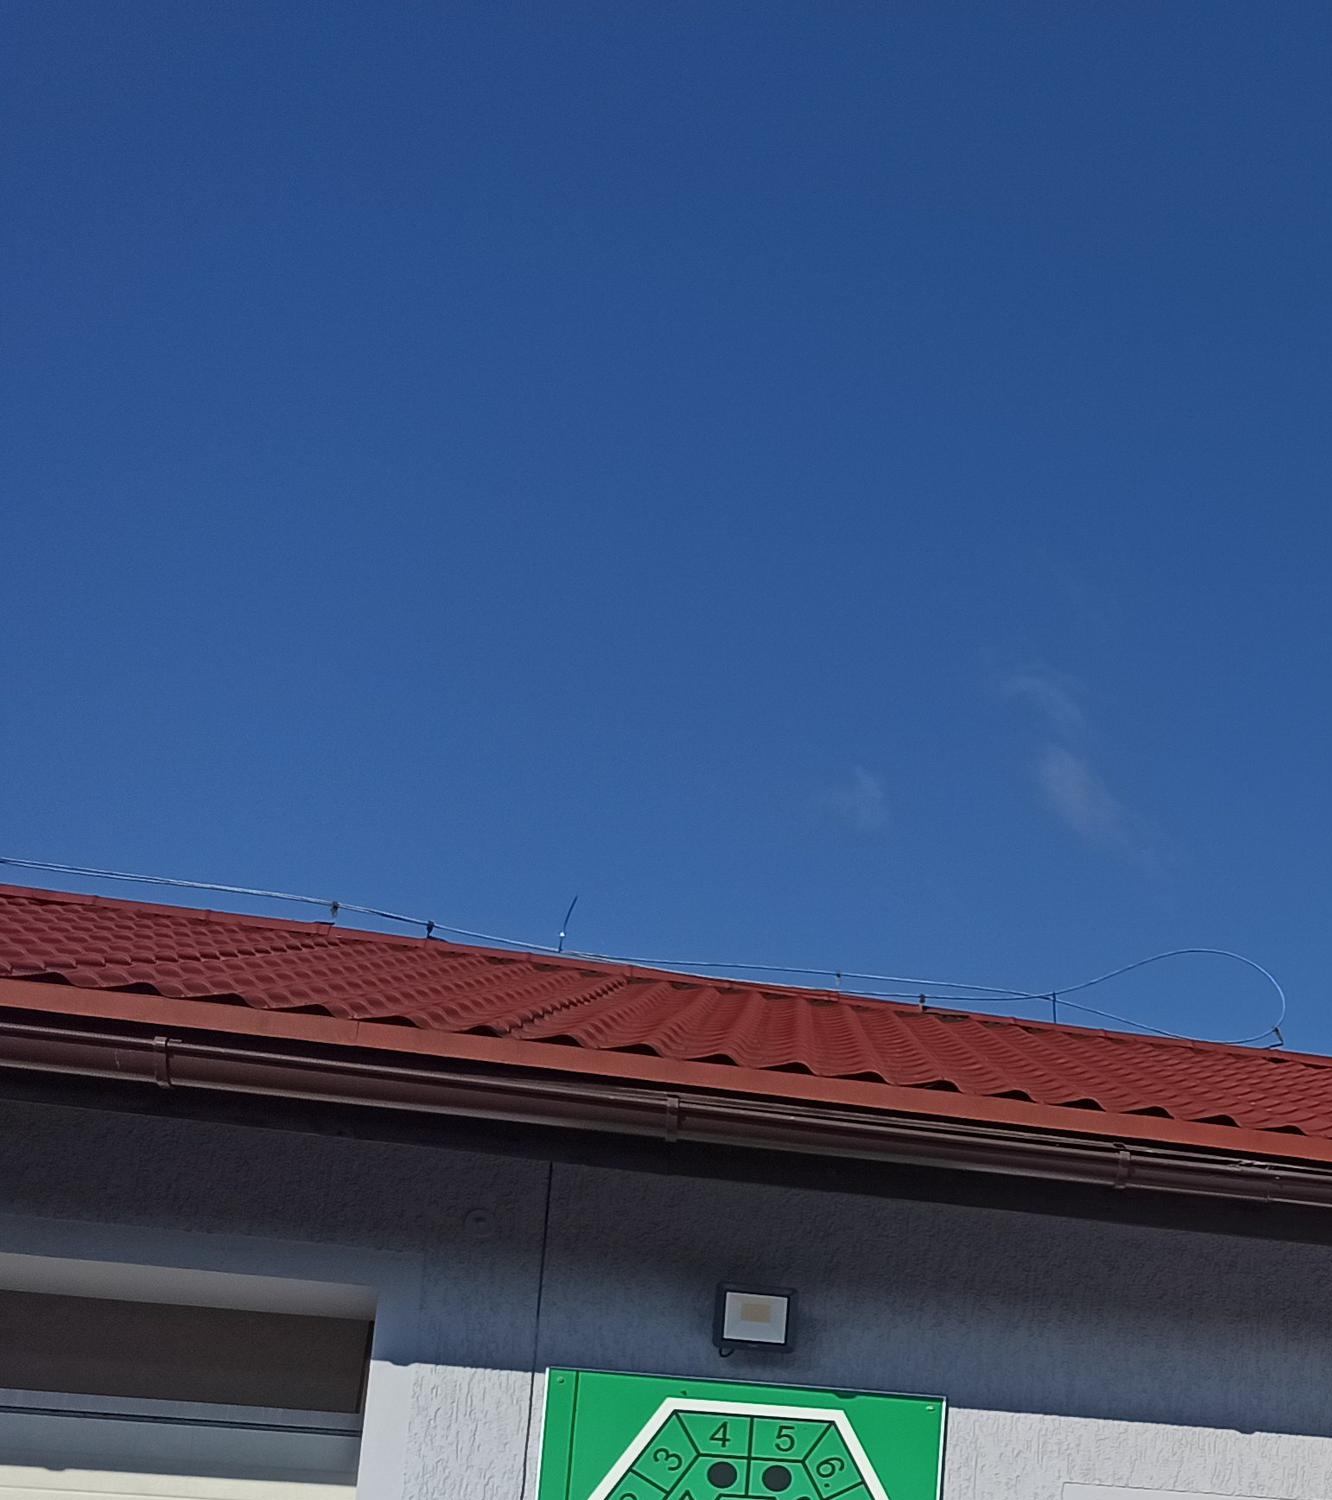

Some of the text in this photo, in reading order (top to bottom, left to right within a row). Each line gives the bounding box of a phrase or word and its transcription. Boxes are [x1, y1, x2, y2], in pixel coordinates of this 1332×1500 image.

[710, 1421, 731, 1448] 4
[775, 1425, 796, 1452] 5
[653, 1447, 683, 1472] 3
